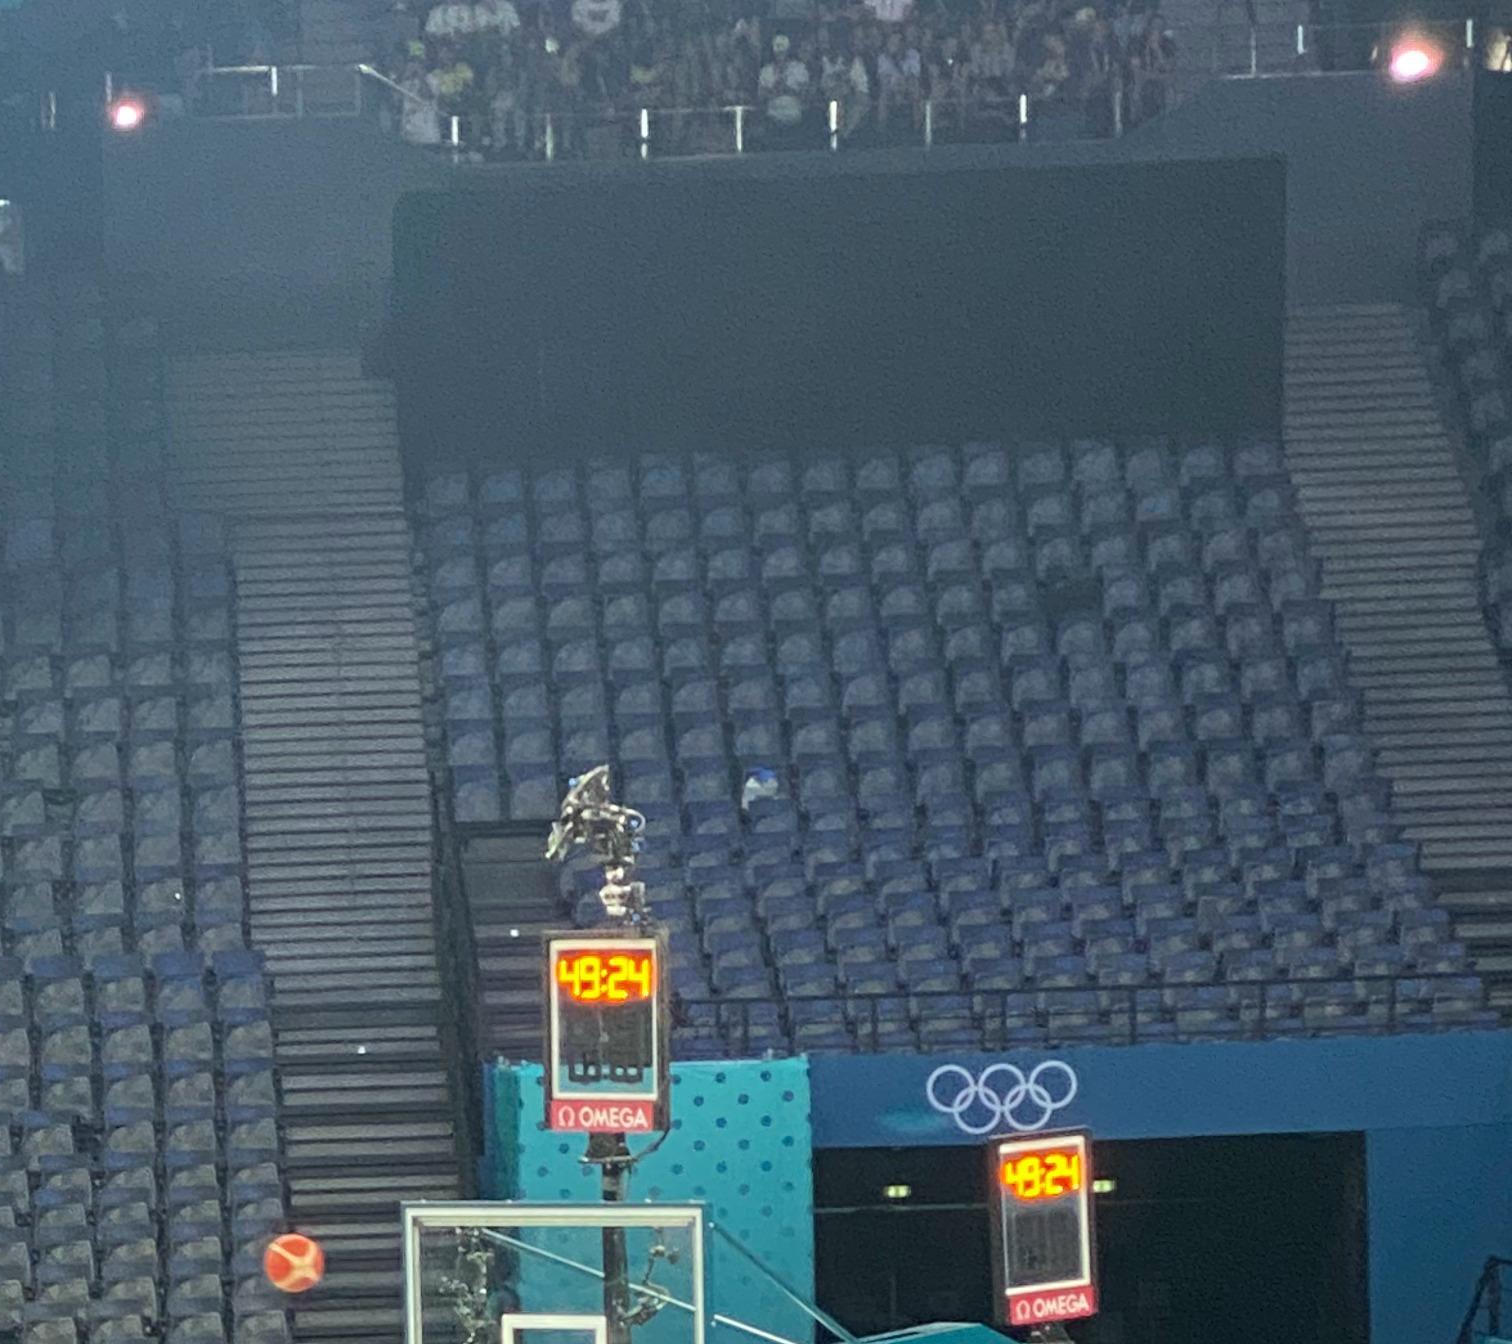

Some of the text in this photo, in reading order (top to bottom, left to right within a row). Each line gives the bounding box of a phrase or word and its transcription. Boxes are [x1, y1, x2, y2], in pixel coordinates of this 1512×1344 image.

[559, 956, 650, 999] 49:24
[579, 1107, 648, 1128] OMEGA
[1033, 1293, 1089, 1318] OMEGA
